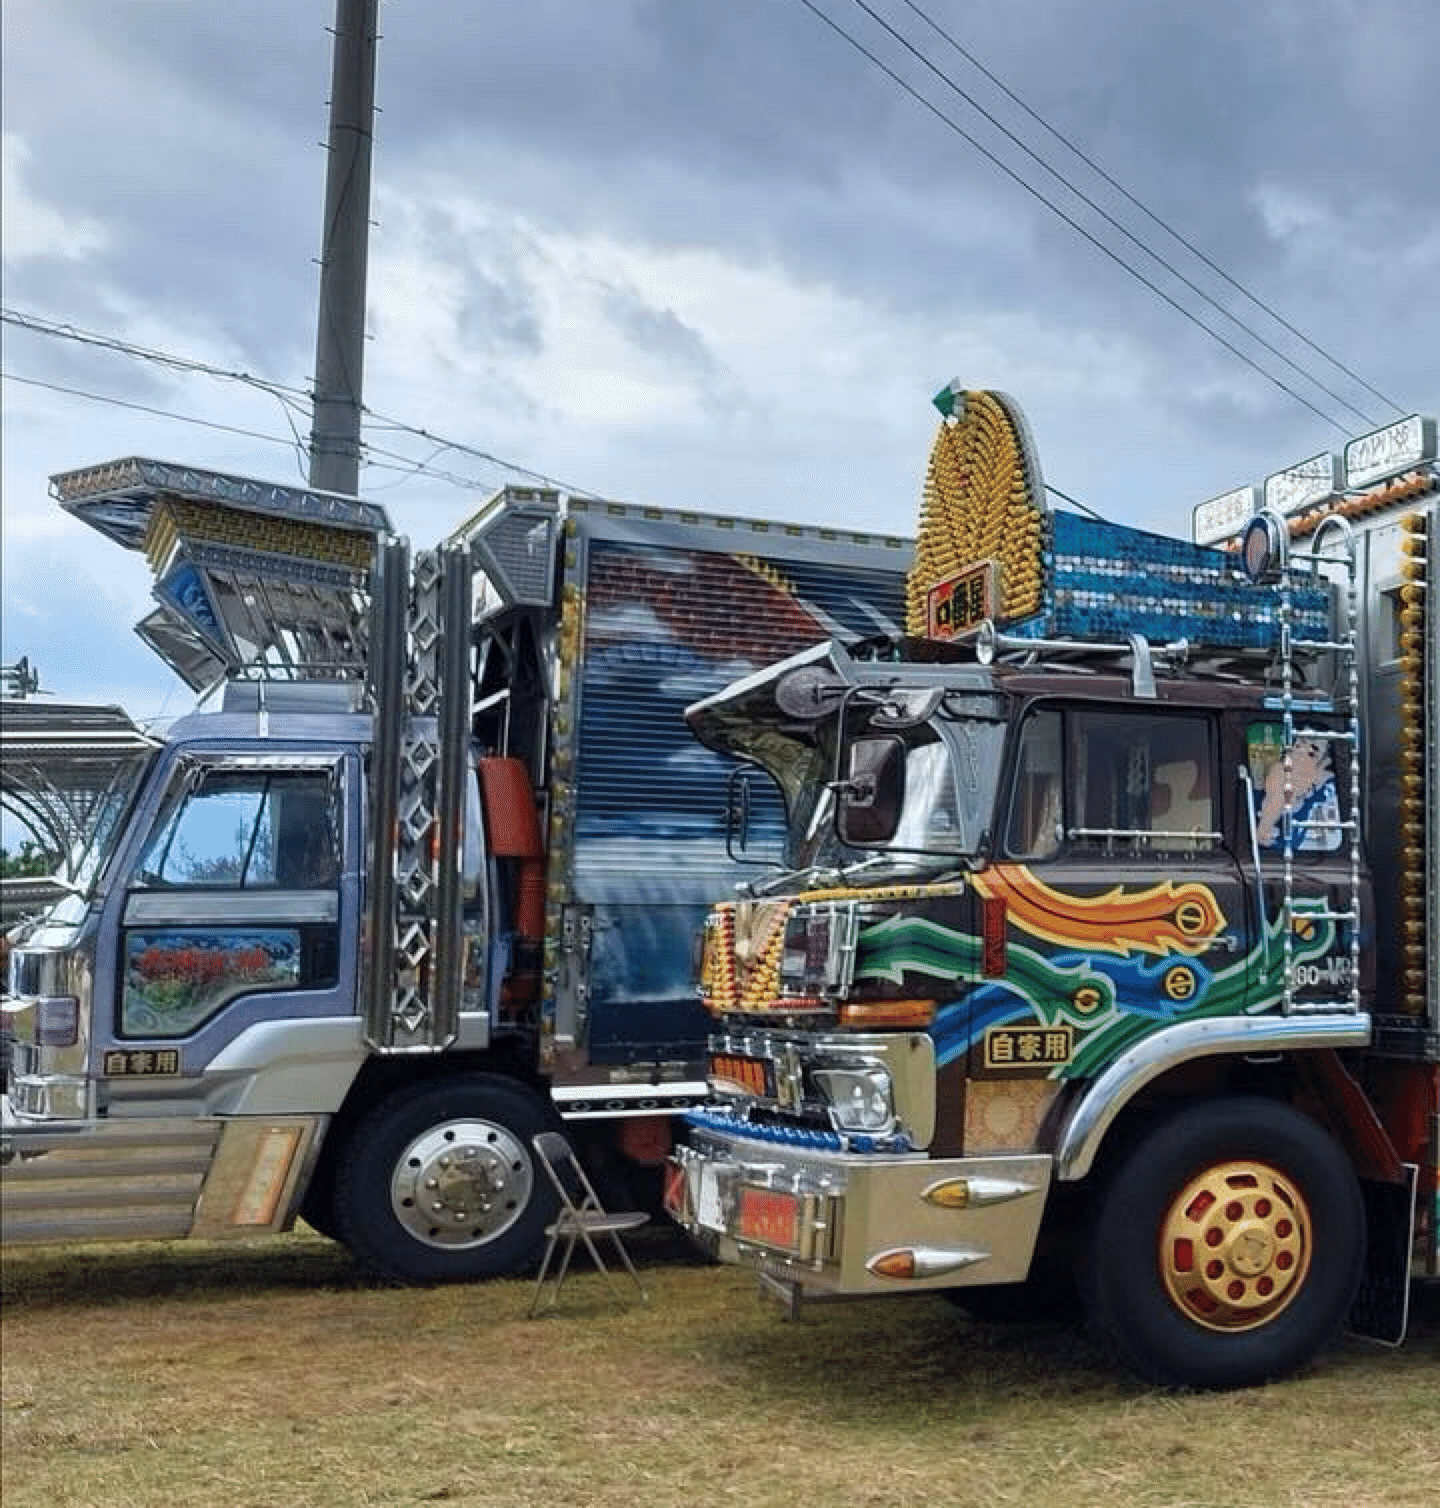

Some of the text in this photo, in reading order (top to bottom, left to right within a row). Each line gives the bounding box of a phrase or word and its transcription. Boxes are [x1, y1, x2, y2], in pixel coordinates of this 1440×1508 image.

[992, 1033, 1067, 1061] 自家用
[107, 1051, 177, 1074] 自家用
